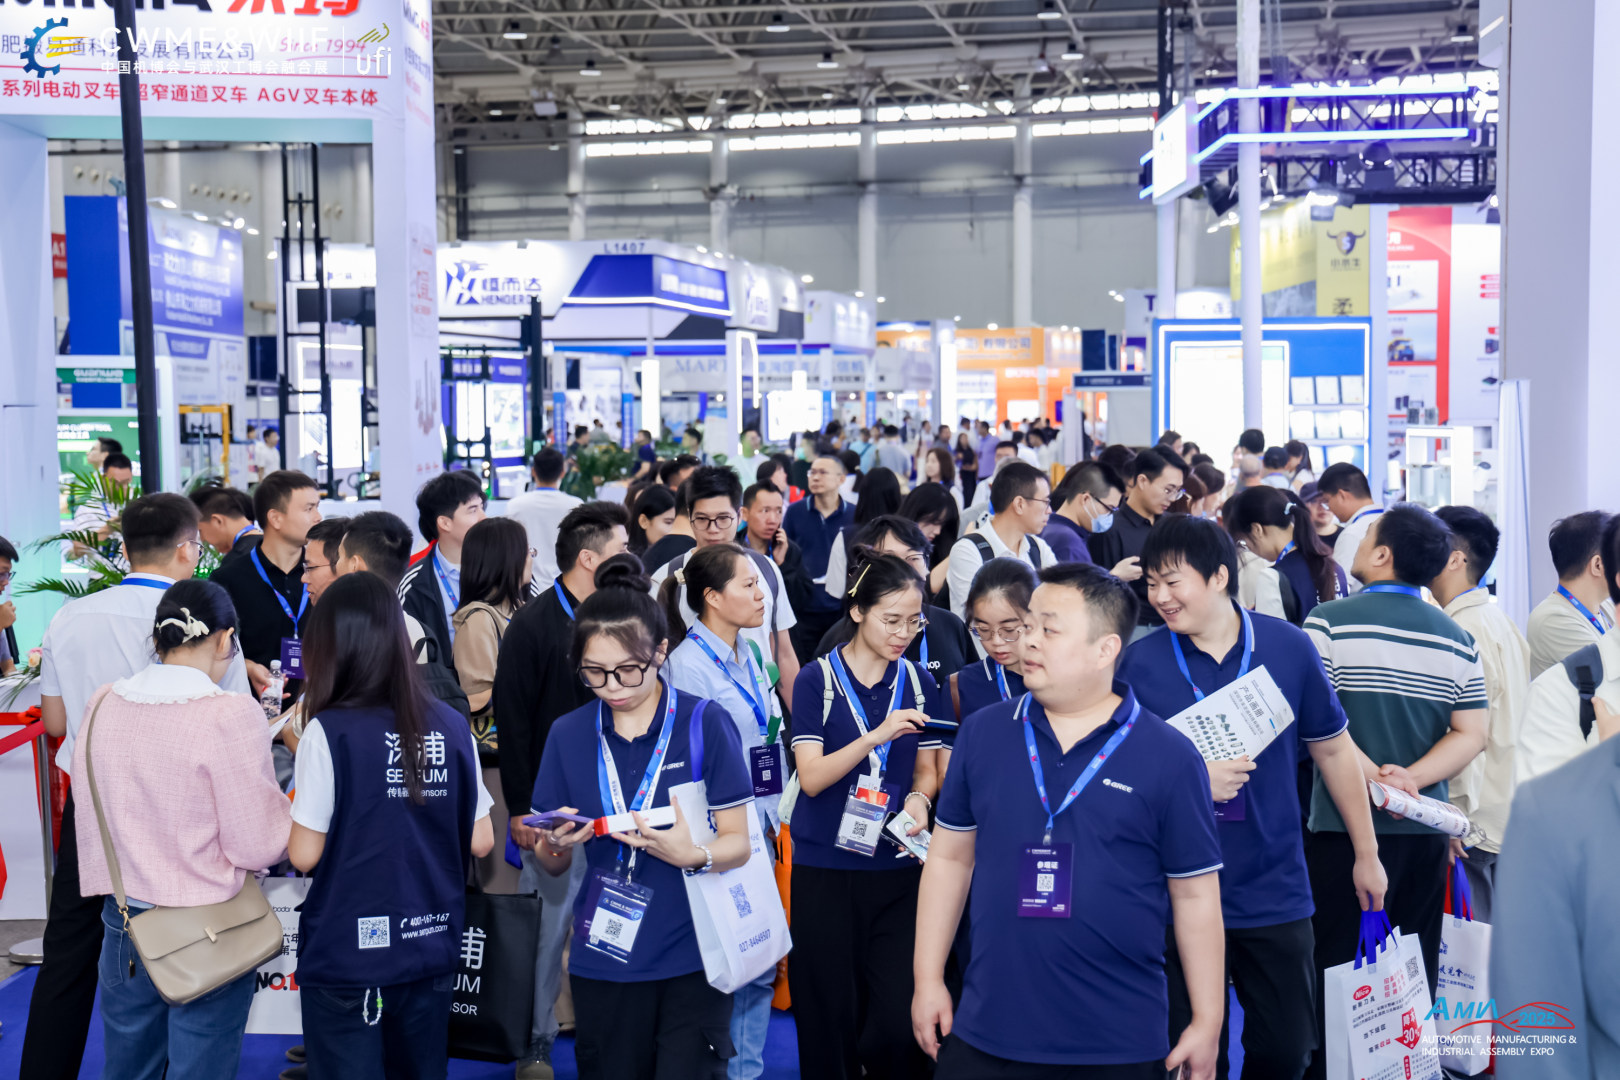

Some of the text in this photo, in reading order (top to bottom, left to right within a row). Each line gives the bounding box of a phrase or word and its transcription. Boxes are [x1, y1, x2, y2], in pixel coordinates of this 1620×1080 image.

[326, 39, 366, 53] 1994
[258, 87, 378, 106] AGV叉车本体
[604, 243, 645, 254] L1407
[386, 768, 448, 782] SEUM
[421, 789, 448, 797] ensors
[1111, 782, 1133, 793] GREE
